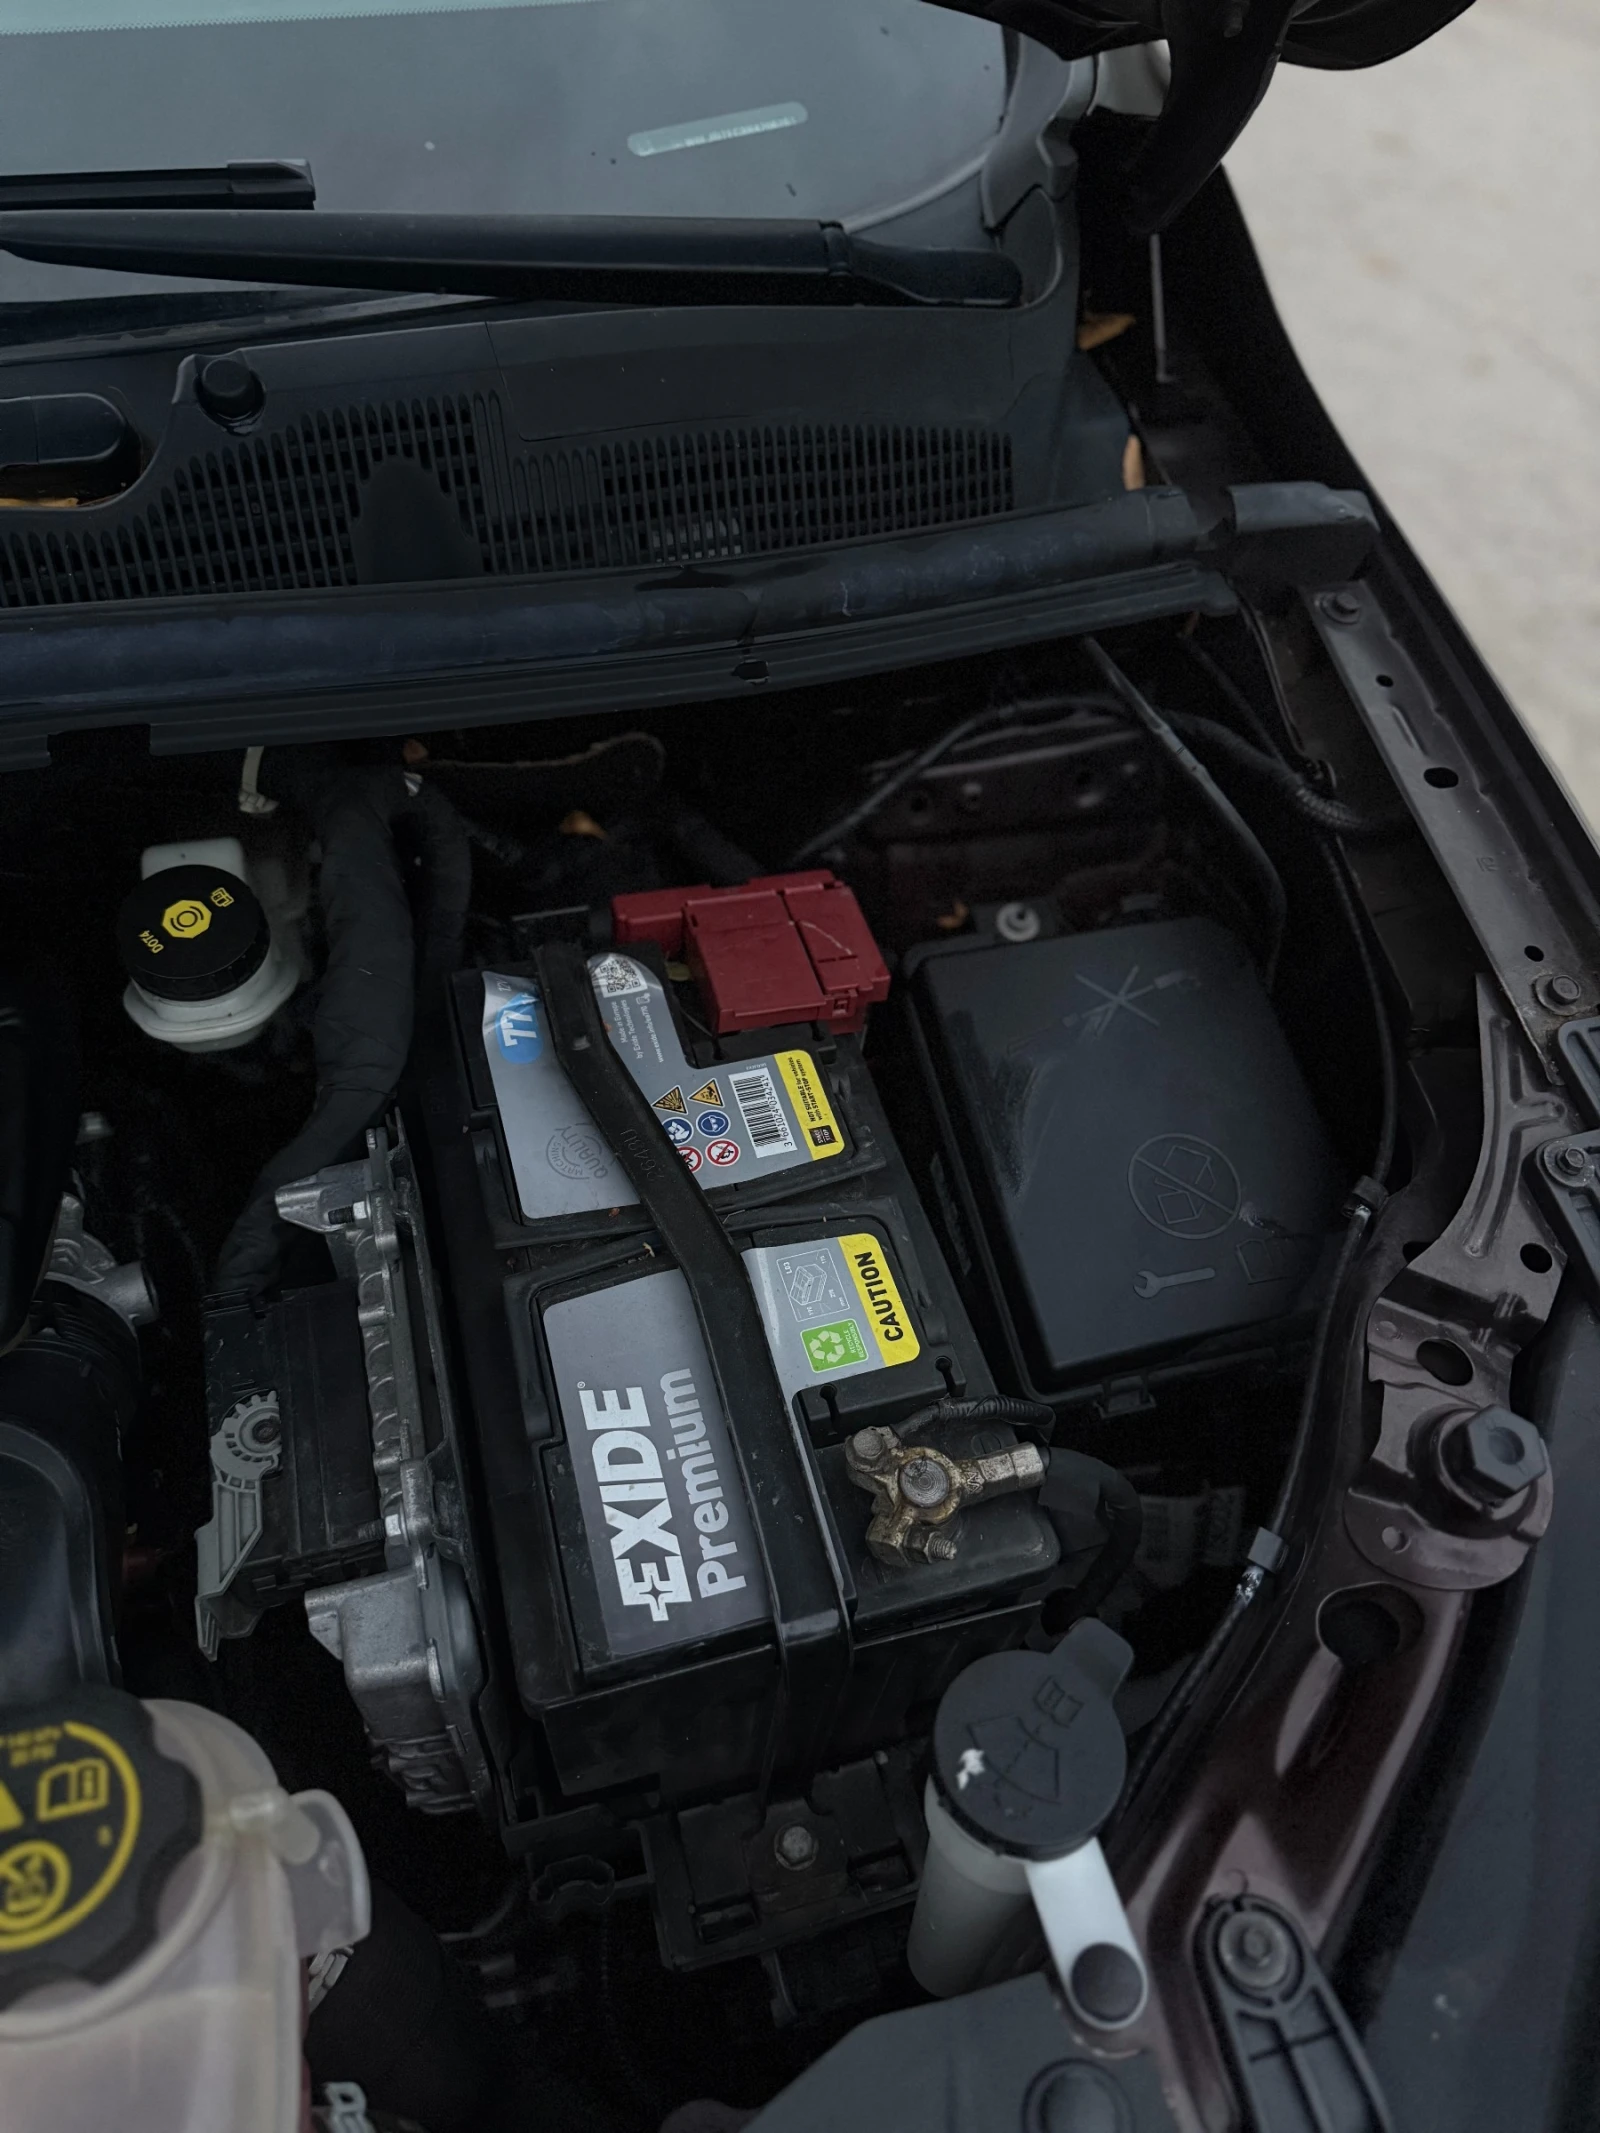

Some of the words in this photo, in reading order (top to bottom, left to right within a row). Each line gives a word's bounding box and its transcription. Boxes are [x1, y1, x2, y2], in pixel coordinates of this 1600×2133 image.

[138, 929, 164, 954] DOT4
[611, 1001, 621, 1021] Europe
[620, 999, 635, 1035] Technologies
[501, 1010, 537, 1047] 77
[619, 1027, 628, 1043] Made
[631, 1035, 641, 1051] Exide
[636, 1051, 644, 1059] by
[788, 1057, 799, 1077] vehicles
[796, 1059, 806, 1077] system
[763, 1076, 777, 1106] 034241
[797, 1085, 811, 1111] SUITABLE
[802, 1078, 818, 1109] START-STOP
[773, 1108, 789, 1137] 661024
[807, 1111, 816, 1122] NOT
[814, 1109, 823, 1120] with
[555, 1126, 609, 1179] QUALITY
[854, 1251, 904, 1342] CAUTION
[843, 1330, 857, 1354] RECYCLE
[848, 1322, 865, 1358] RESPONSIBLY
[660, 1368, 747, 1598] Premium
[579, 1387, 692, 1621] EXIDE
